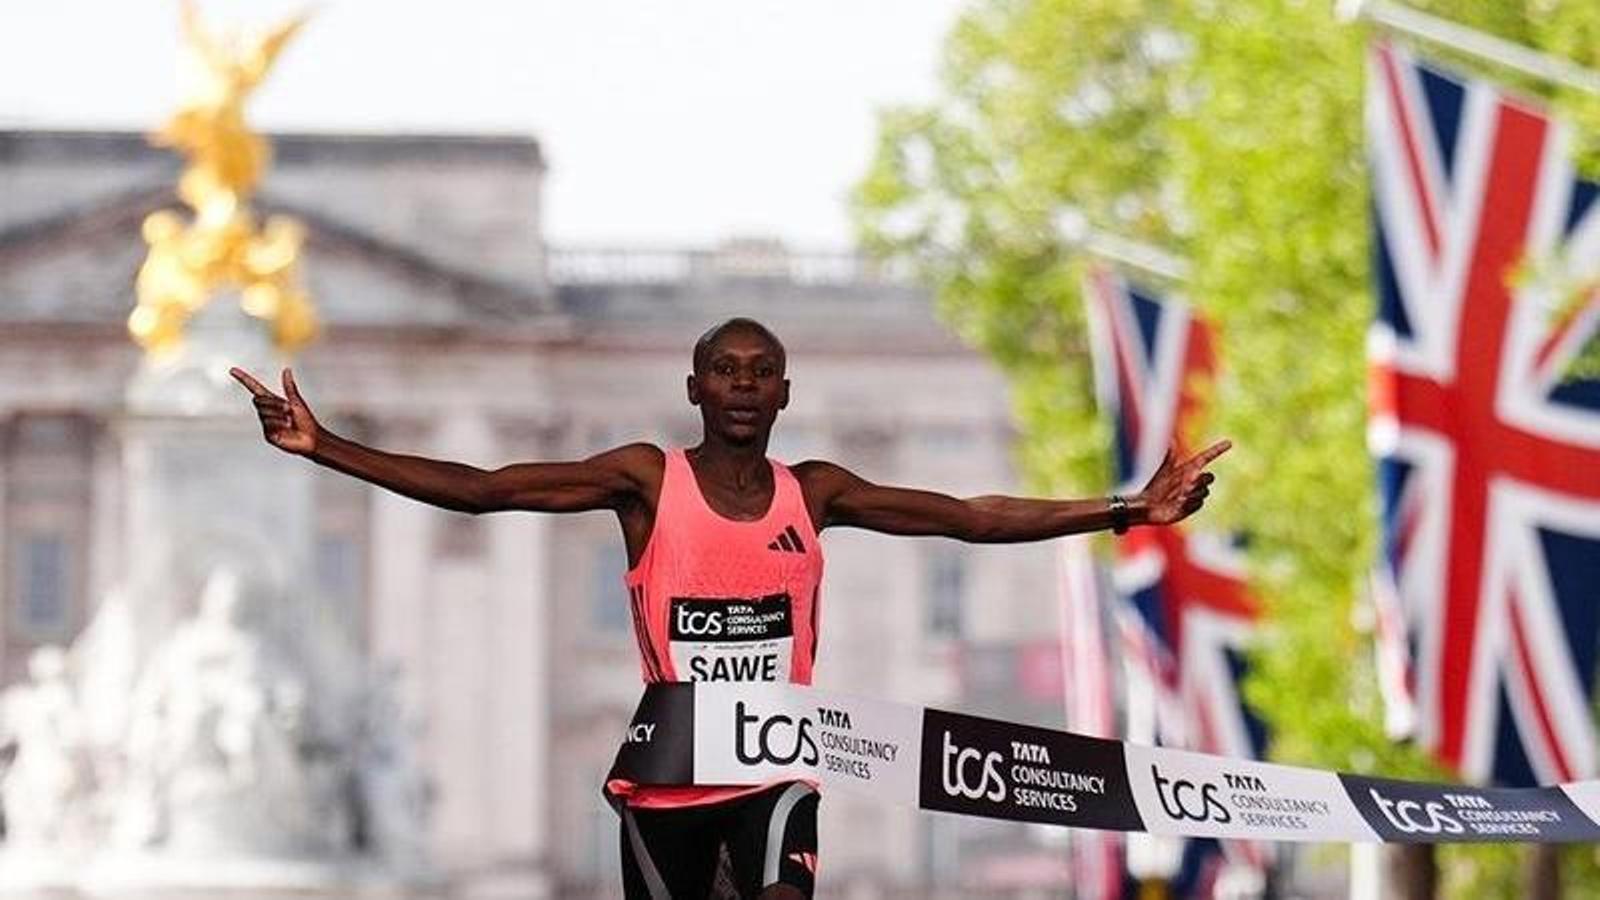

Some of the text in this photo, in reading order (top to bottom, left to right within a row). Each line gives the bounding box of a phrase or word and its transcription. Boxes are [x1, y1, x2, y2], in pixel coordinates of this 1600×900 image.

[677, 604, 722, 634] tcs
[727, 605, 754, 615] TATA
[726, 624, 768, 636] SERVICES
[690, 654, 778, 682] SAWE
[817, 707, 850, 730] TATA
[735, 701, 820, 767] tcs
[820, 730, 899, 762] CONSULTANCY
[1011, 741, 1050, 765] TATA
[824, 752, 871, 780] SERVICES
[942, 730, 1007, 803] tcs
[1010, 765, 1105, 795] CONSULTANCY
[1223, 773, 1266, 793] TATA
[1013, 787, 1078, 812] SERVICES
[1151, 763, 1231, 824] tcs
[1230, 793, 1330, 817] CONSULTANCY
[1442, 793, 1493, 810] TATA
[1239, 811, 1308, 830] SERVICES
[1369, 787, 1464, 834] tcs
[1457, 809, 1562, 824] CONSULTANCY
[1469, 822, 1541, 836] SERVICES
